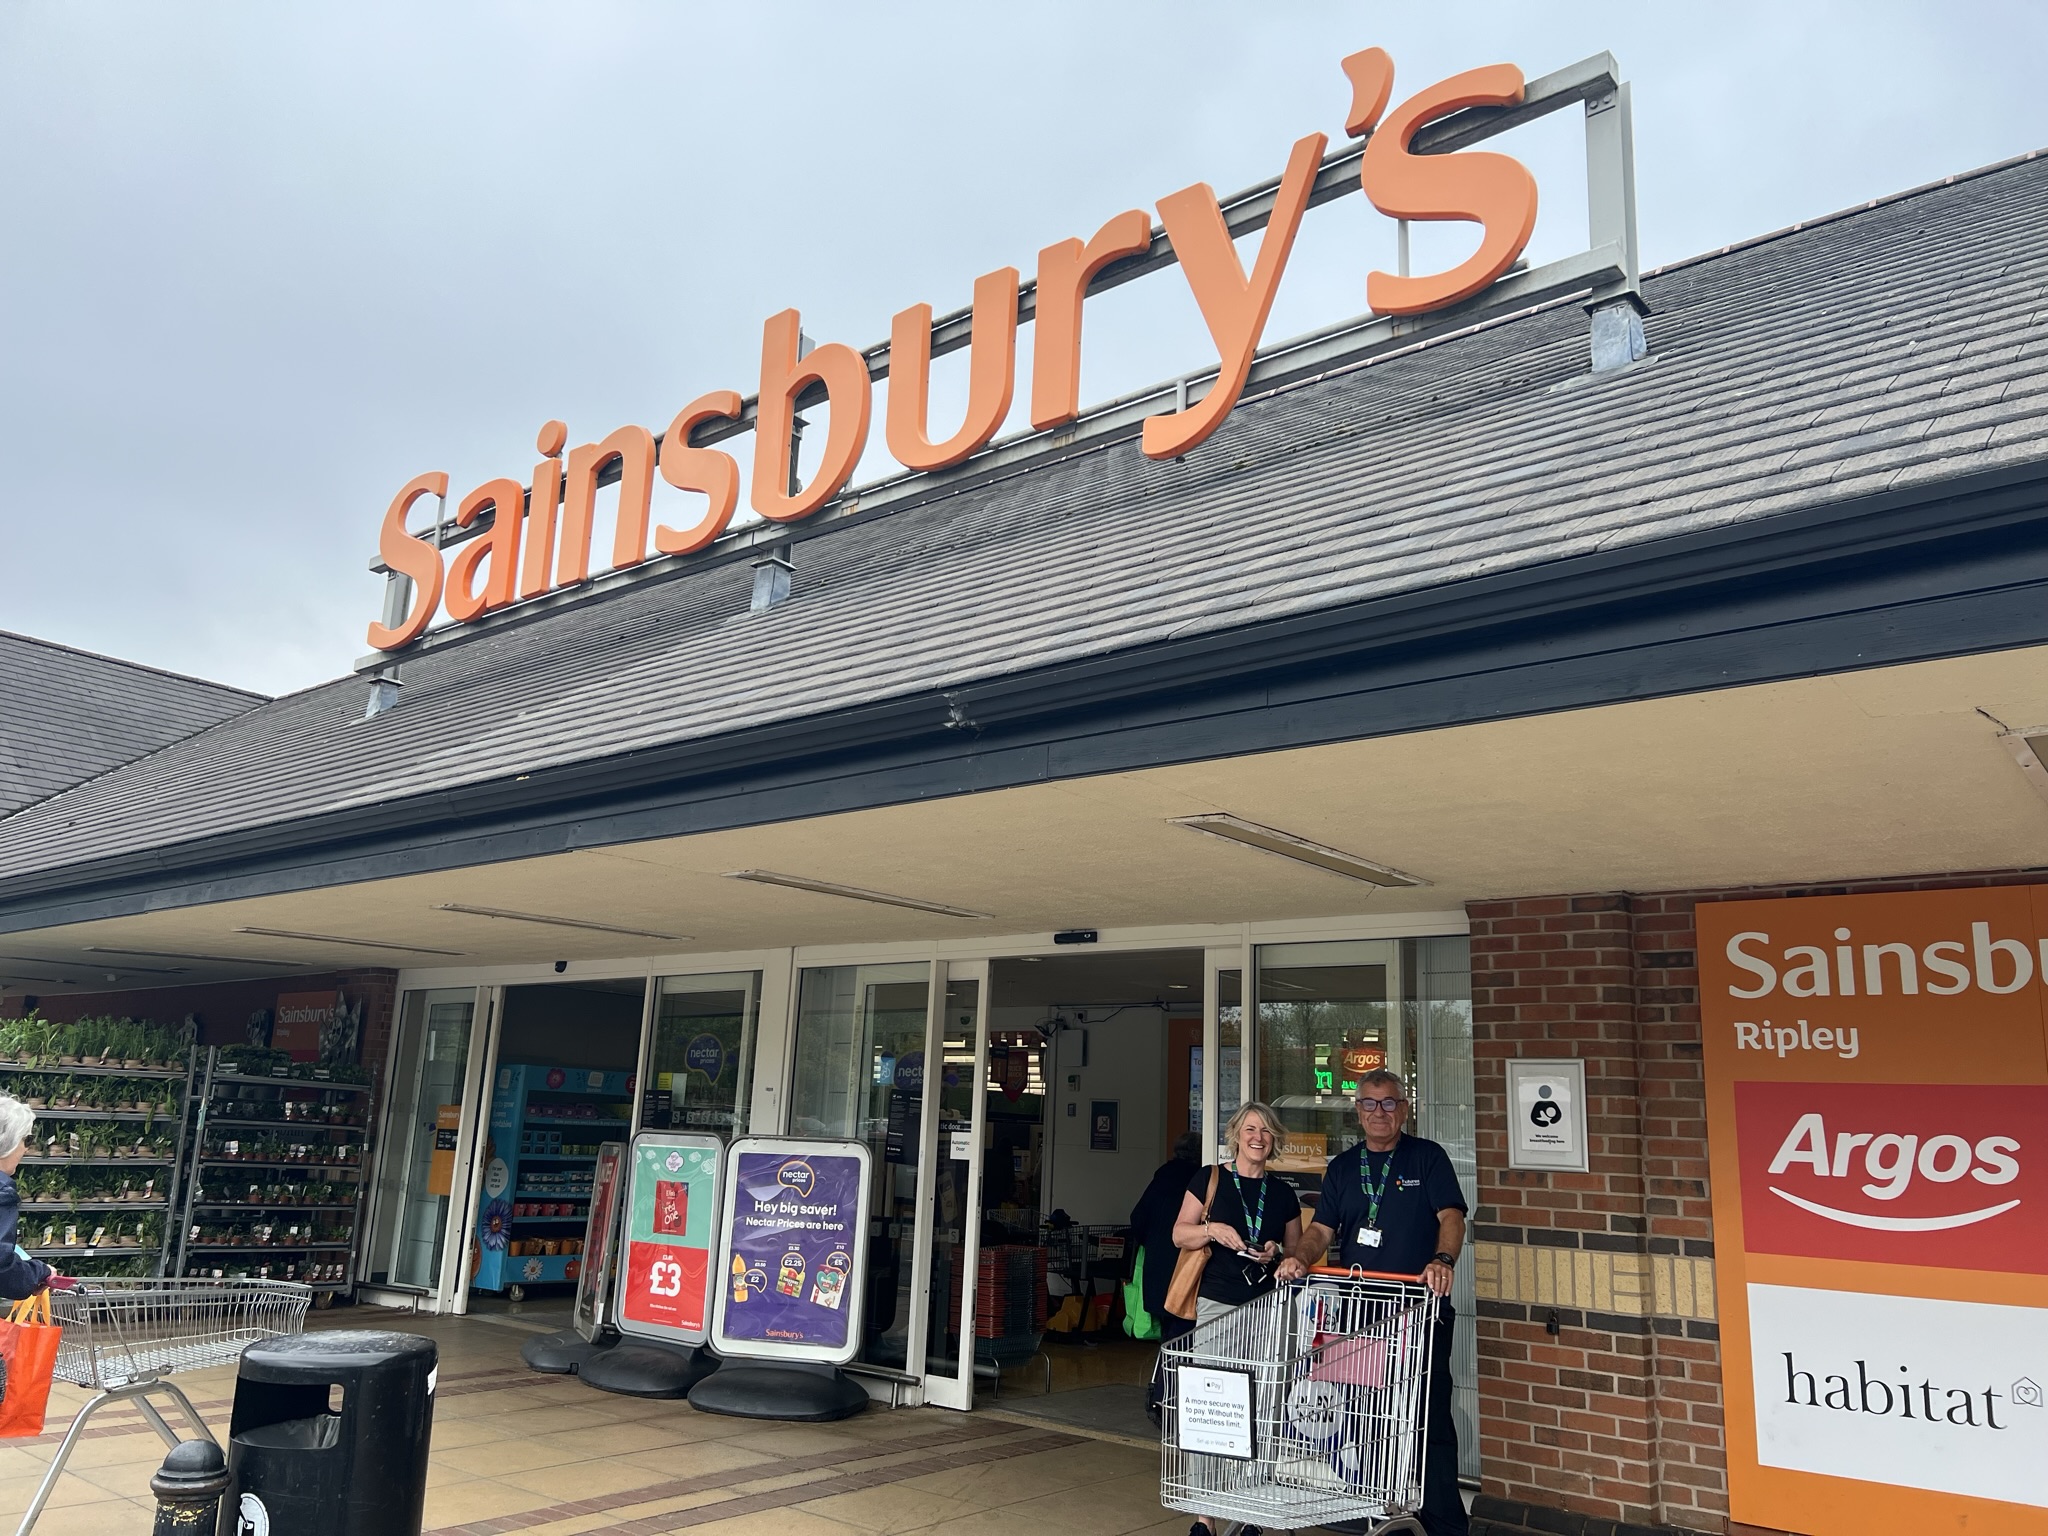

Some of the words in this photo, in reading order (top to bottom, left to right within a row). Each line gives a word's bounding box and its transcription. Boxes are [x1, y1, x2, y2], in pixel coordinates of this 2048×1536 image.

[367, 46, 1539, 652] Sainsbury's
[1726, 922, 2048, 999] Sainsb
[279, 1005, 335, 1024] Sainsbury's
[1734, 1020, 1859, 1059] Ripley
[690, 1048, 720, 1058] nectar
[1344, 1052, 1380, 1068] Argos
[898, 1065, 924, 1077] nect
[1767, 1113, 2021, 1200] Argos
[783, 1170, 810, 1179] nectar
[754, 1200, 778, 1215] Hey
[780, 1202, 798, 1216] big
[800, 1204, 837, 1216] saver!
[746, 1217, 775, 1227] Nectar
[777, 1218, 805, 1229] Prices
[806, 1221, 822, 1230] are
[823, 1220, 844, 1231] here
[650, 1261, 682, 1297] £3
[765, 1328, 804, 1340] Sainsbury's
[1211, 1382, 1221, 1390] Pay
[1780, 1351, 2008, 1430] habitat
[1185, 1396, 1190, 1404] A
[1191, 1398, 1208, 1406] more
[1209, 1400, 1231, 1409] secure
[1232, 1402, 1245, 1412] way
[1185, 1406, 1193, 1414] to
[1193, 1408, 1206, 1416] pay.
[1208, 1408, 1233, 1419] Without
[1234, 1411, 1245, 1420] the
[1188, 1416, 1225, 1427] contactless
[1226, 1419, 1242, 1429] limit.
